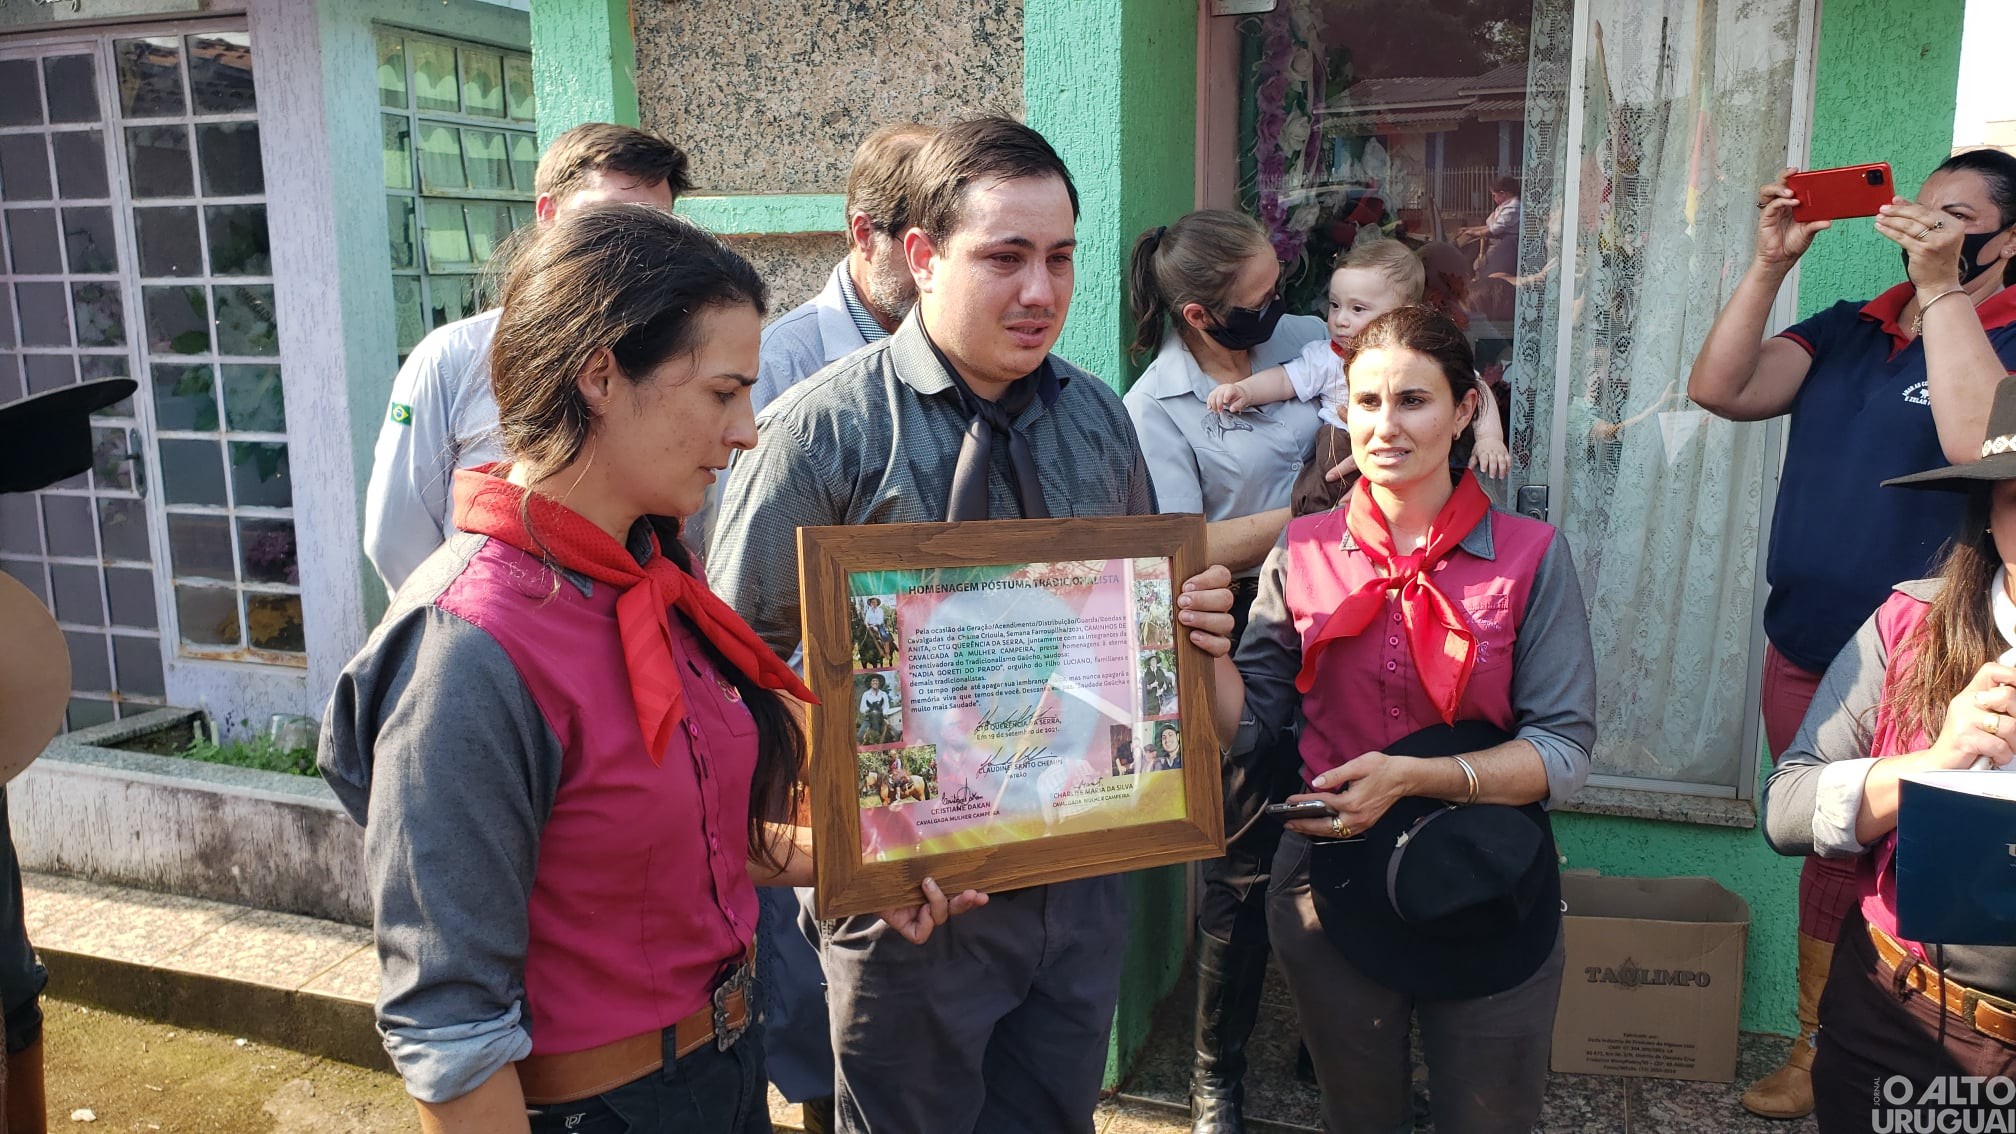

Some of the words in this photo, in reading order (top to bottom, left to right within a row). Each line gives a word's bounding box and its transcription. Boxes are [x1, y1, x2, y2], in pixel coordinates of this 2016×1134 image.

[908, 582, 979, 595] HOMENAGEM
[981, 578, 1031, 591] PÓSTUMA
[1033, 575, 1120, 588] TRADICIONALISTA
[908, 635, 944, 645] Cavalgadas
[947, 634, 955, 642] da
[980, 631, 1006, 639] Crioula,
[1084, 623, 1118, 631] CAMINHOS
[908, 645, 931, 653] ANITA,
[937, 643, 951, 651] CTG
[952, 641, 991, 650] QUERÊNCIA
[1002, 638, 1025, 646] SERRA,
[1027, 637, 1063, 645] juntamente
[1085, 631, 1119, 640] integrantes
[908, 653, 950, 662] CAVALGADA
[968, 648, 997, 657] MULHER
[1000, 645, 1036, 654] CAMPEIRA,
[1062, 642, 1100, 650] homenagens
[908, 661, 954, 670] incentivadora
[966, 656, 1016, 666] Tradicionalismo
[1017, 653, 1043, 661] Gaúcho,
[1043, 652, 1070, 660] saudosa:
[937, 668, 962, 676] GORETI
[1007, 662, 1032, 671] orgulho
[1045, 659, 1061, 667] Filho
[1063, 657, 1093, 666] LUCIANO,
[1094, 655, 1124, 663] familiares
[909, 680, 934, 688] demais
[934, 675, 987, 685] tradicionalistas.
[927, 686, 949, 695] tempo
[951, 685, 968, 693] pode
[981, 682, 1004, 690] apagar
[1101, 671, 1125, 679] apagará
[910, 695, 940, 704] memória
[959, 693, 972, 701] que
[1004, 687, 1021, 695] você.
[1103, 679, 1126, 687] Gaúcha
[911, 705, 931, 713] muito
[1014, 761, 1036, 770] SANTO
[1116, 783, 1134, 791] SILVA
[1104, 793, 1130, 801] CAMPEIRA
[931, 806, 967, 816] CRISTIANE
[967, 801, 991, 811] DAKAN
[916, 817, 949, 827] CAVALGADA
[949, 813, 972, 822] MULHER
